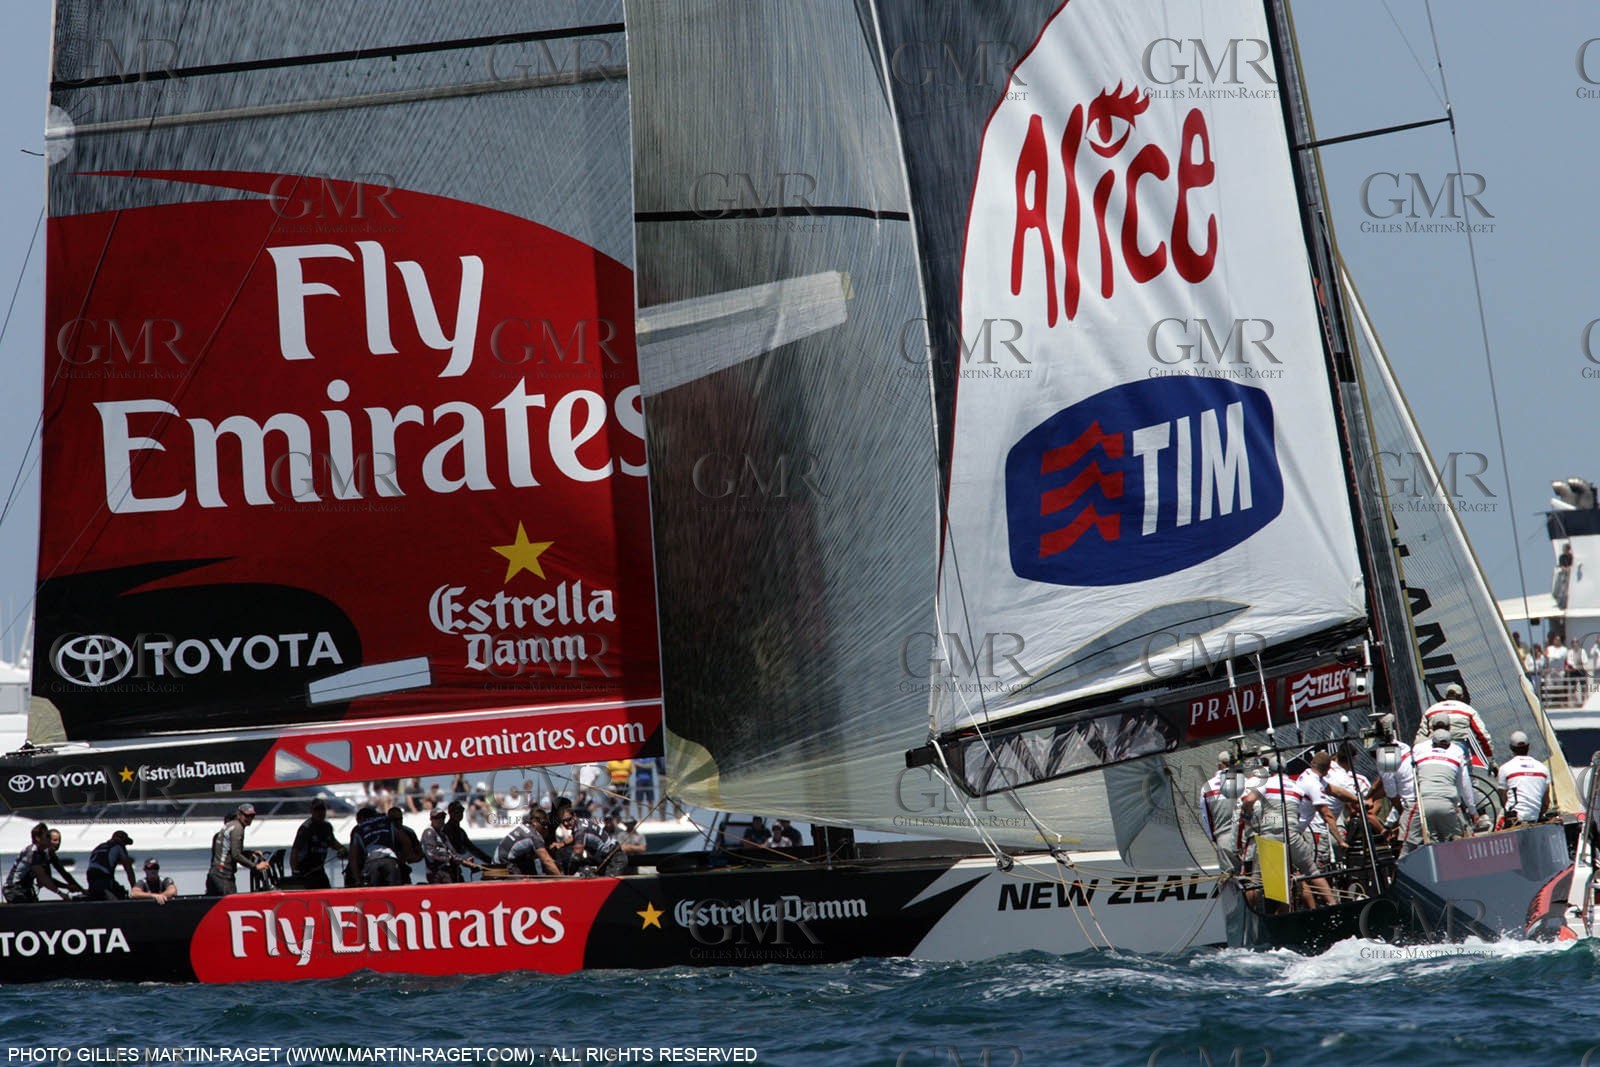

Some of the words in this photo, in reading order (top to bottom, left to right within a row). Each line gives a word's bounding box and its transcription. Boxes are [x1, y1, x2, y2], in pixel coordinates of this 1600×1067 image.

[1011, 80, 1218, 328] Alice
[266, 240, 484, 377] Fly
[92, 376, 648, 514] Emirates
[1132, 401, 1253, 536] TIM
[428, 580, 616, 635] Estrella
[144, 631, 343, 676] TOYOTA
[463, 632, 588, 670] Damm
[1317, 667, 1350, 695] TELEC
[1190, 688, 1270, 726] PRADA
[365, 720, 646, 765] www.emirates.com
[36, 771, 107, 789] TOYOTA
[673, 898, 781, 928] Estrella
[783, 895, 868, 924] Damm
[997, 879, 1099, 911] NEW
[0, 927, 131, 957] TOYOTA
[227, 909, 315, 966] Fly
[328, 900, 565, 954] Emirates
